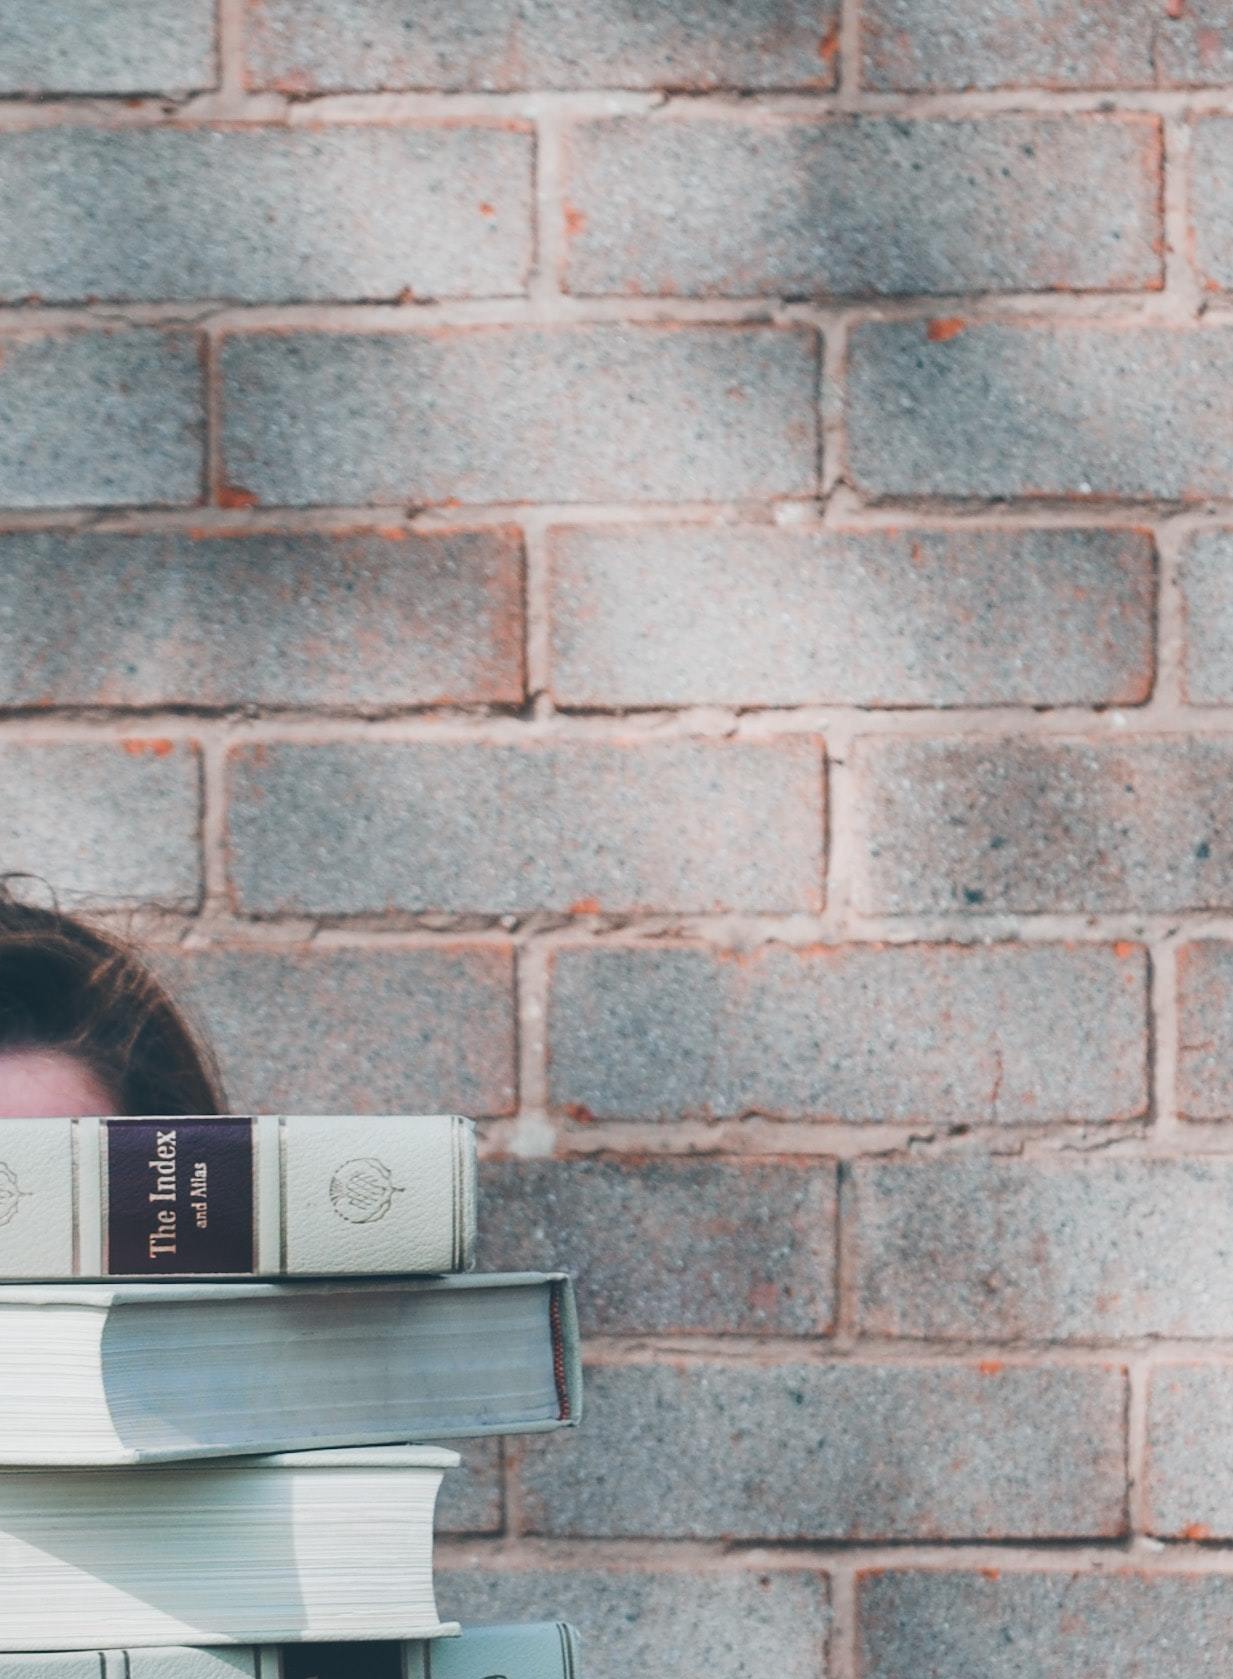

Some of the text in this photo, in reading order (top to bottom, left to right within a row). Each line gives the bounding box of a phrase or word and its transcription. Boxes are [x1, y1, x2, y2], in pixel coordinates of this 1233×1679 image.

[149, 1129, 177, 1259] The Index
[190, 1162, 208, 1229] and Atlas
